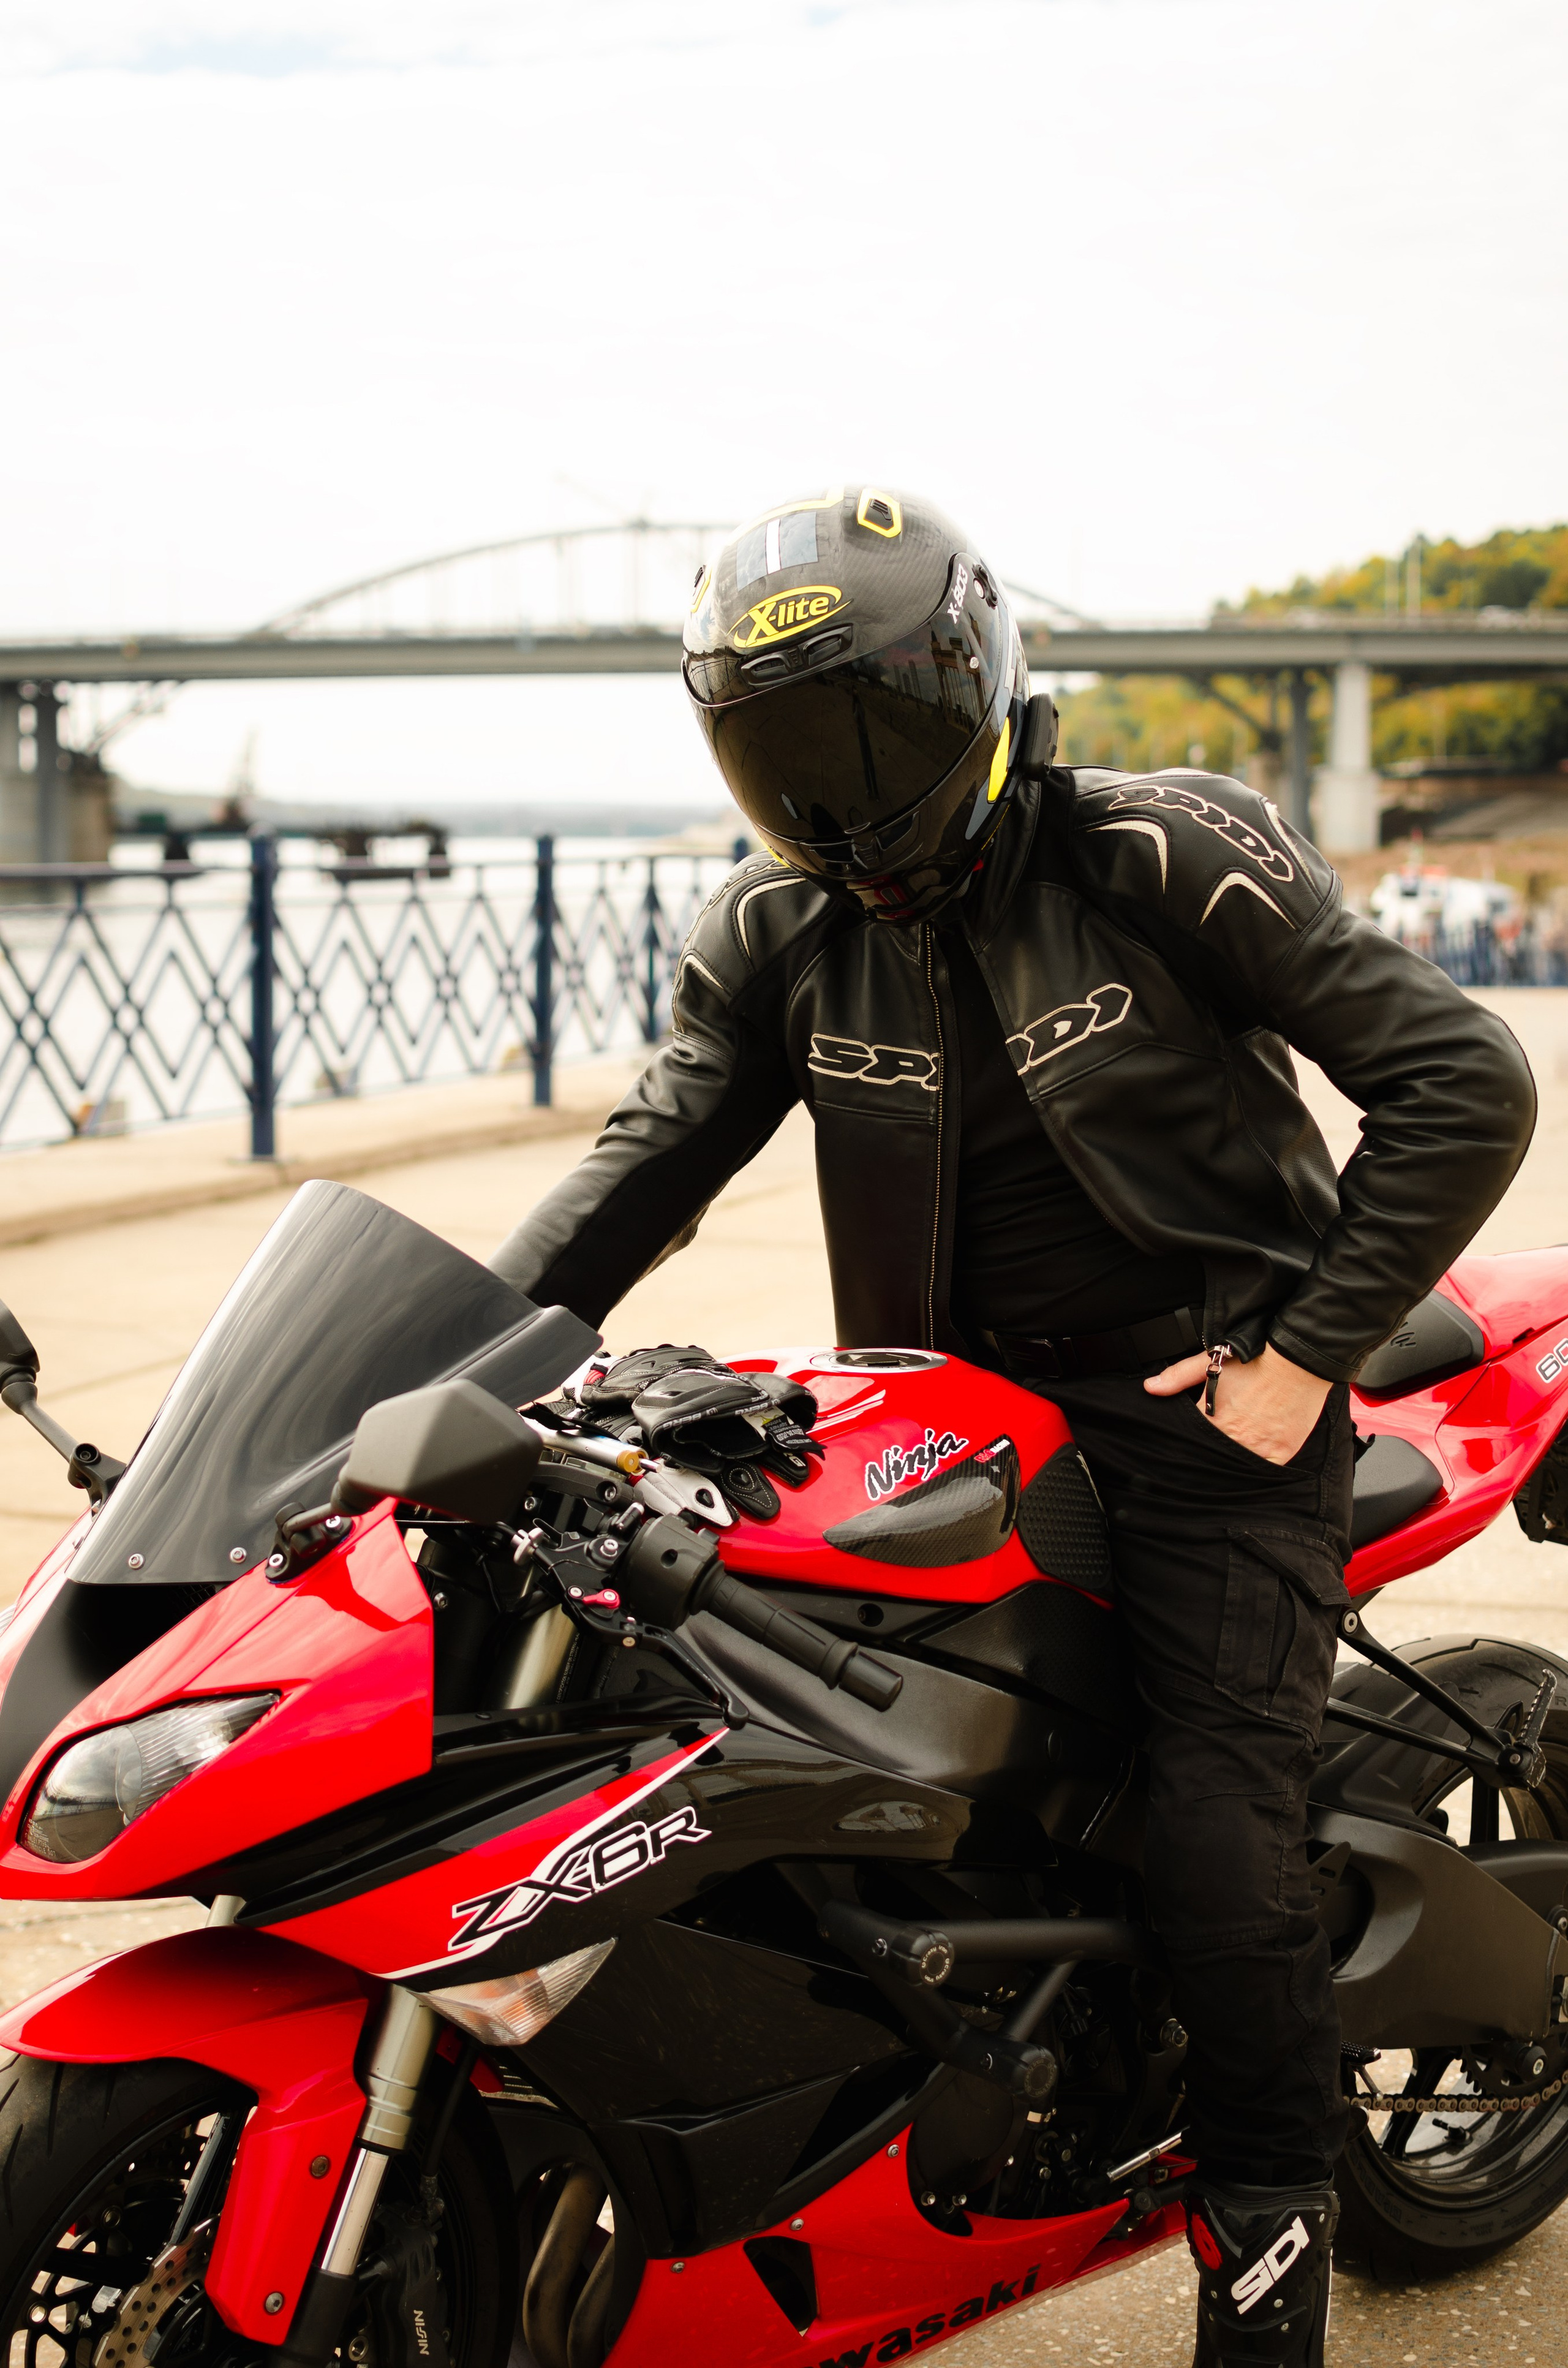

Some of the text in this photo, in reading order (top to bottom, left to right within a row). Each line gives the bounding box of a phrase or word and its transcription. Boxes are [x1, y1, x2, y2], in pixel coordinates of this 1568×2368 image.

[744, 594, 830, 647] X-lite
[947, 562, 968, 623] X-803
[864, 1428, 969, 1501] Ninja
[1231, 2215, 1310, 2315] SIDI
[413, 2310, 429, 2355] NISSIN
[798, 2263, 1041, 2368] wasaki
